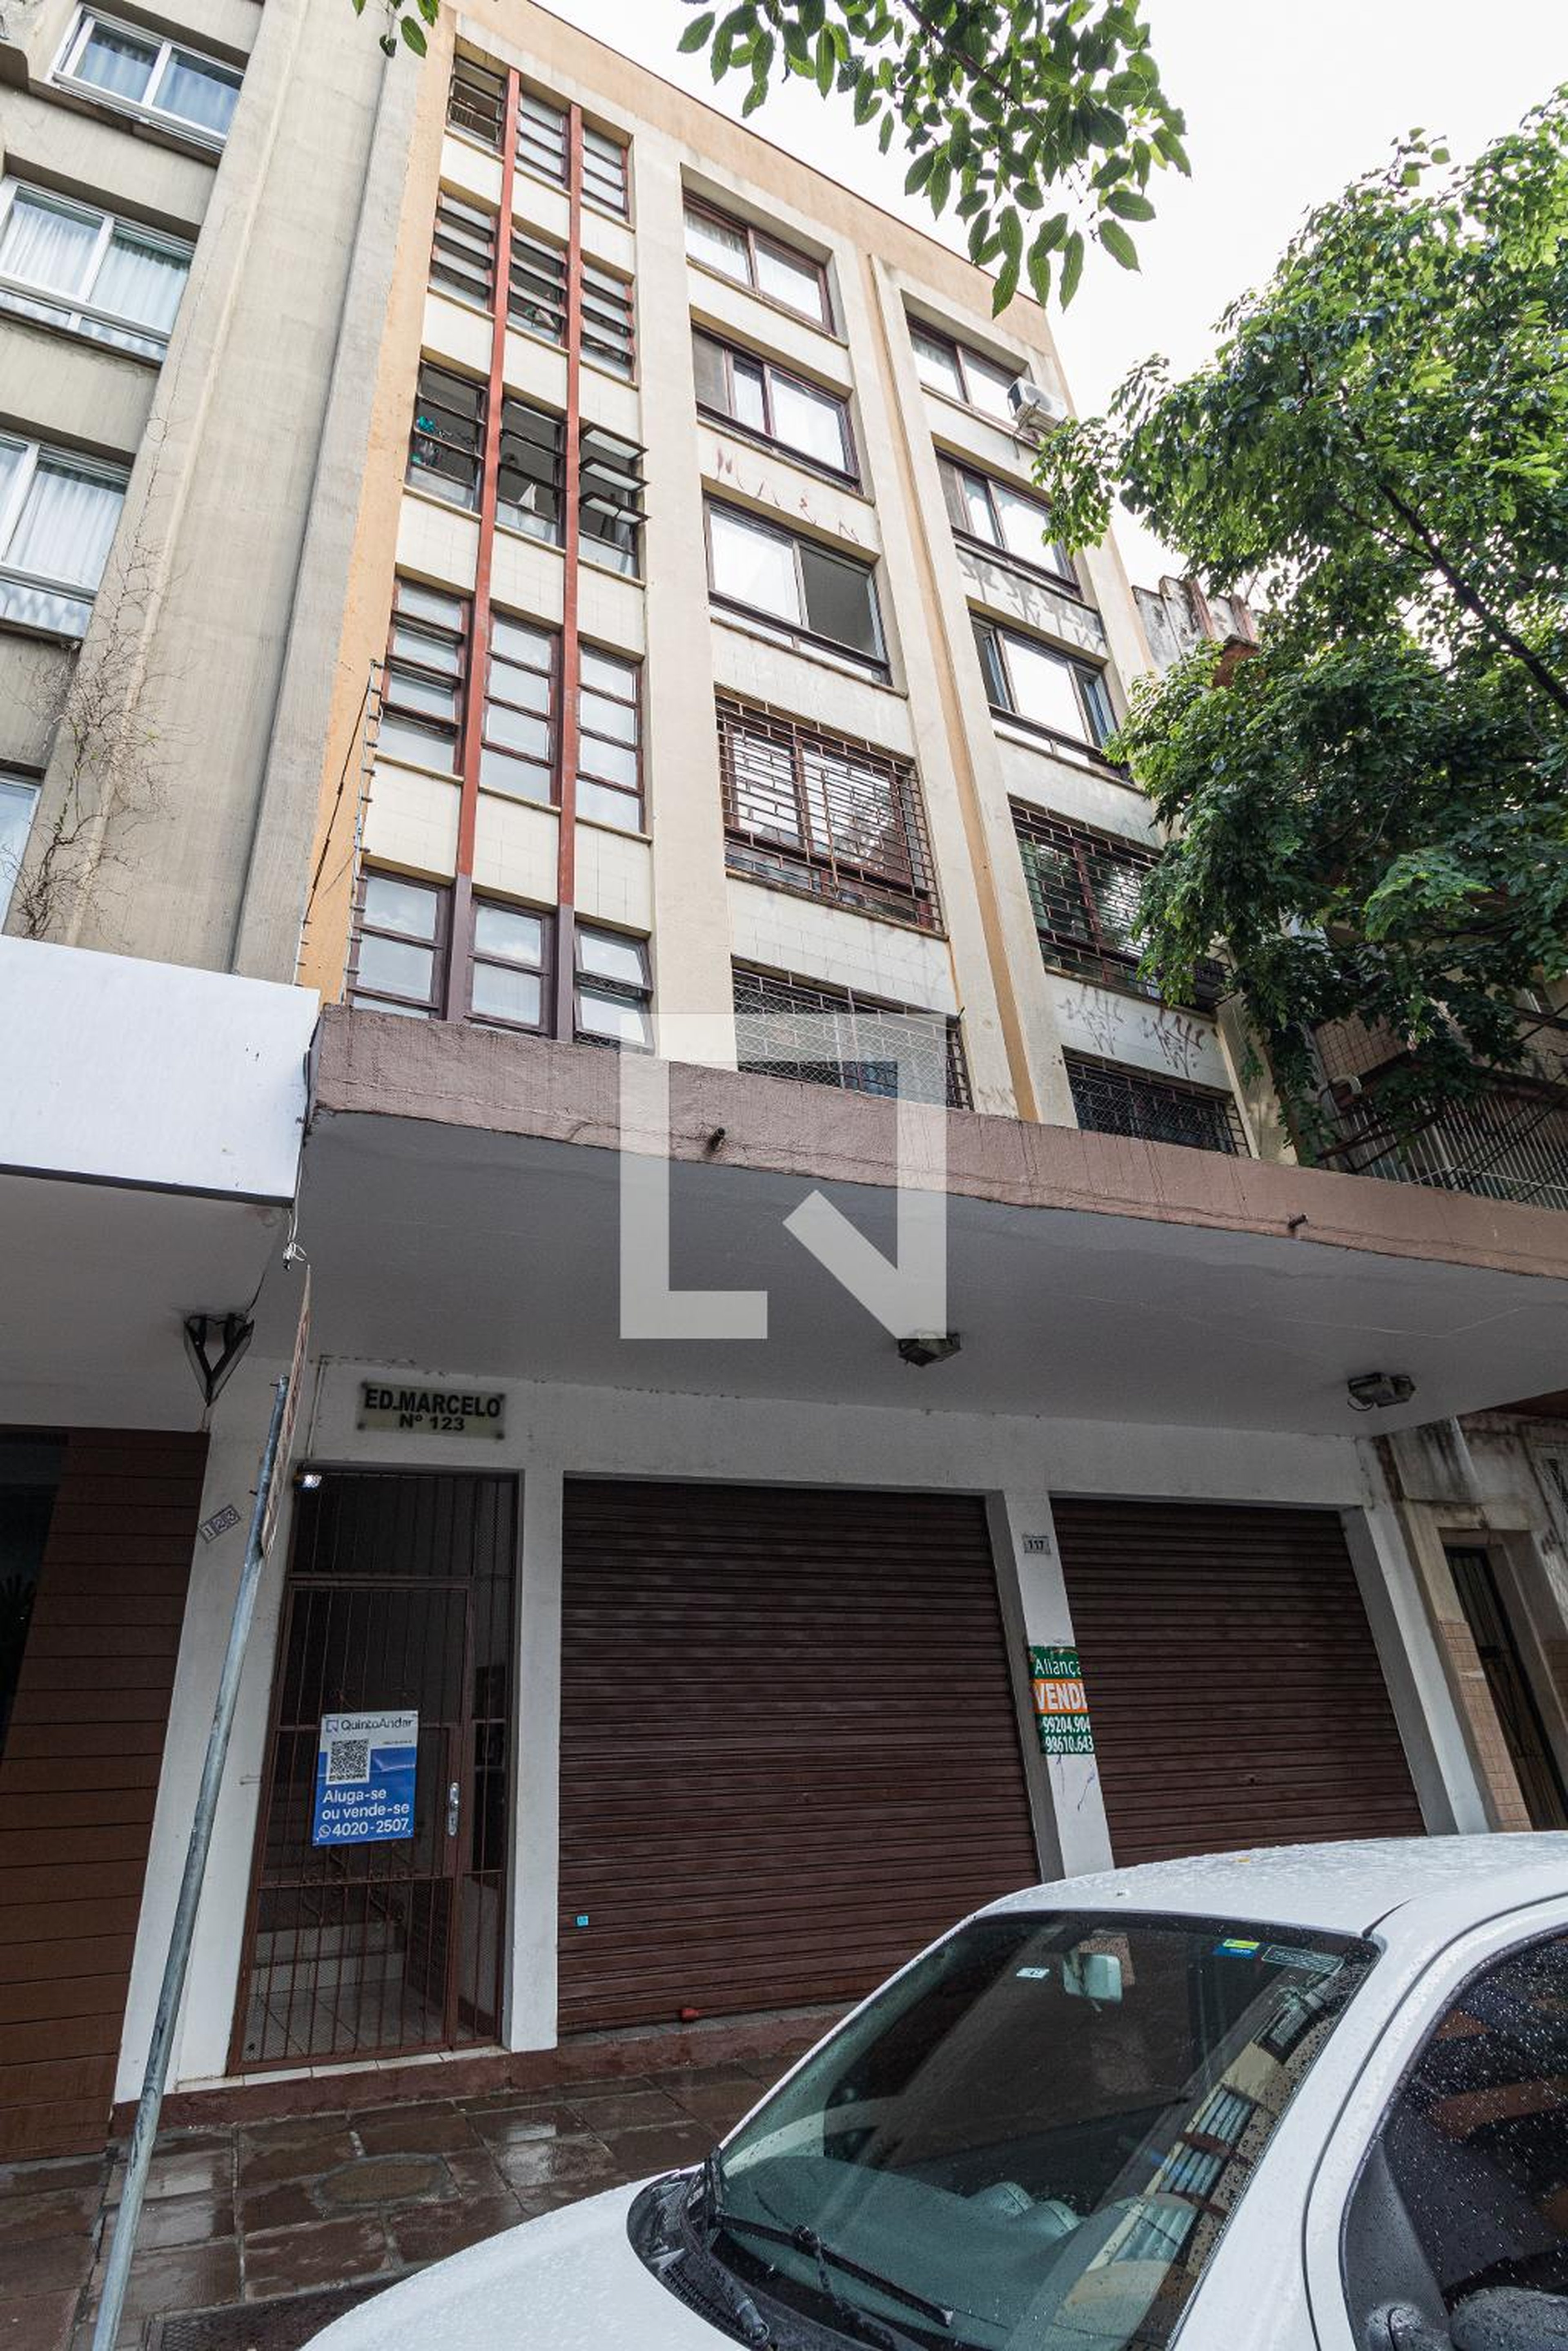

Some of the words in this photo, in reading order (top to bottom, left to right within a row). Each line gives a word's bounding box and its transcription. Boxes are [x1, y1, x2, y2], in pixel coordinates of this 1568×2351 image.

[430, 1416, 465, 1431] 123
[204, 1510, 236, 1537] 123
[341, 1717, 414, 1731] QuintoAndar
[323, 1789, 386, 1805] Aluga-se
[322, 1810, 339, 1820] ou
[344, 1803, 409, 1818] vende-se
